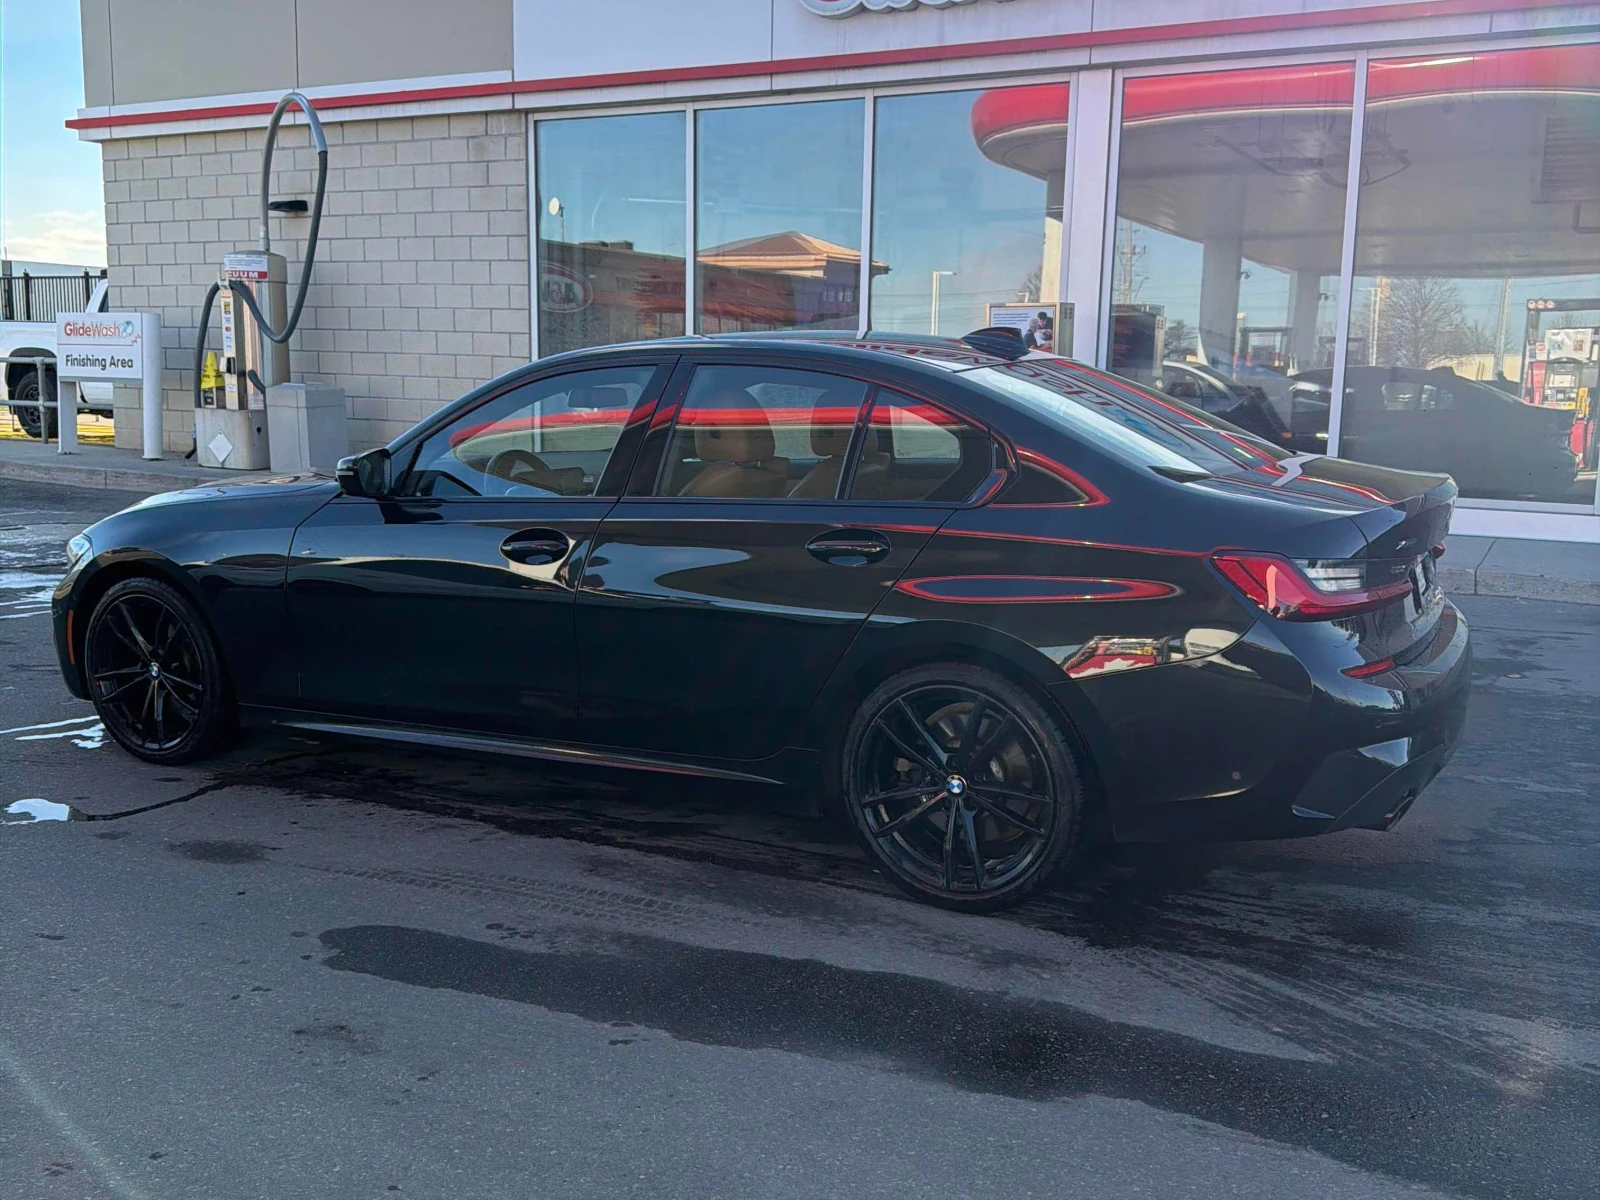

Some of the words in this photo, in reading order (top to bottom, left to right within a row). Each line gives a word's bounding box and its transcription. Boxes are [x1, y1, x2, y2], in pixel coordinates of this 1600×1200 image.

[64, 322, 120, 337] GlideWash
[65, 354, 107, 371] Finishing
[109, 355, 134, 369] Area
